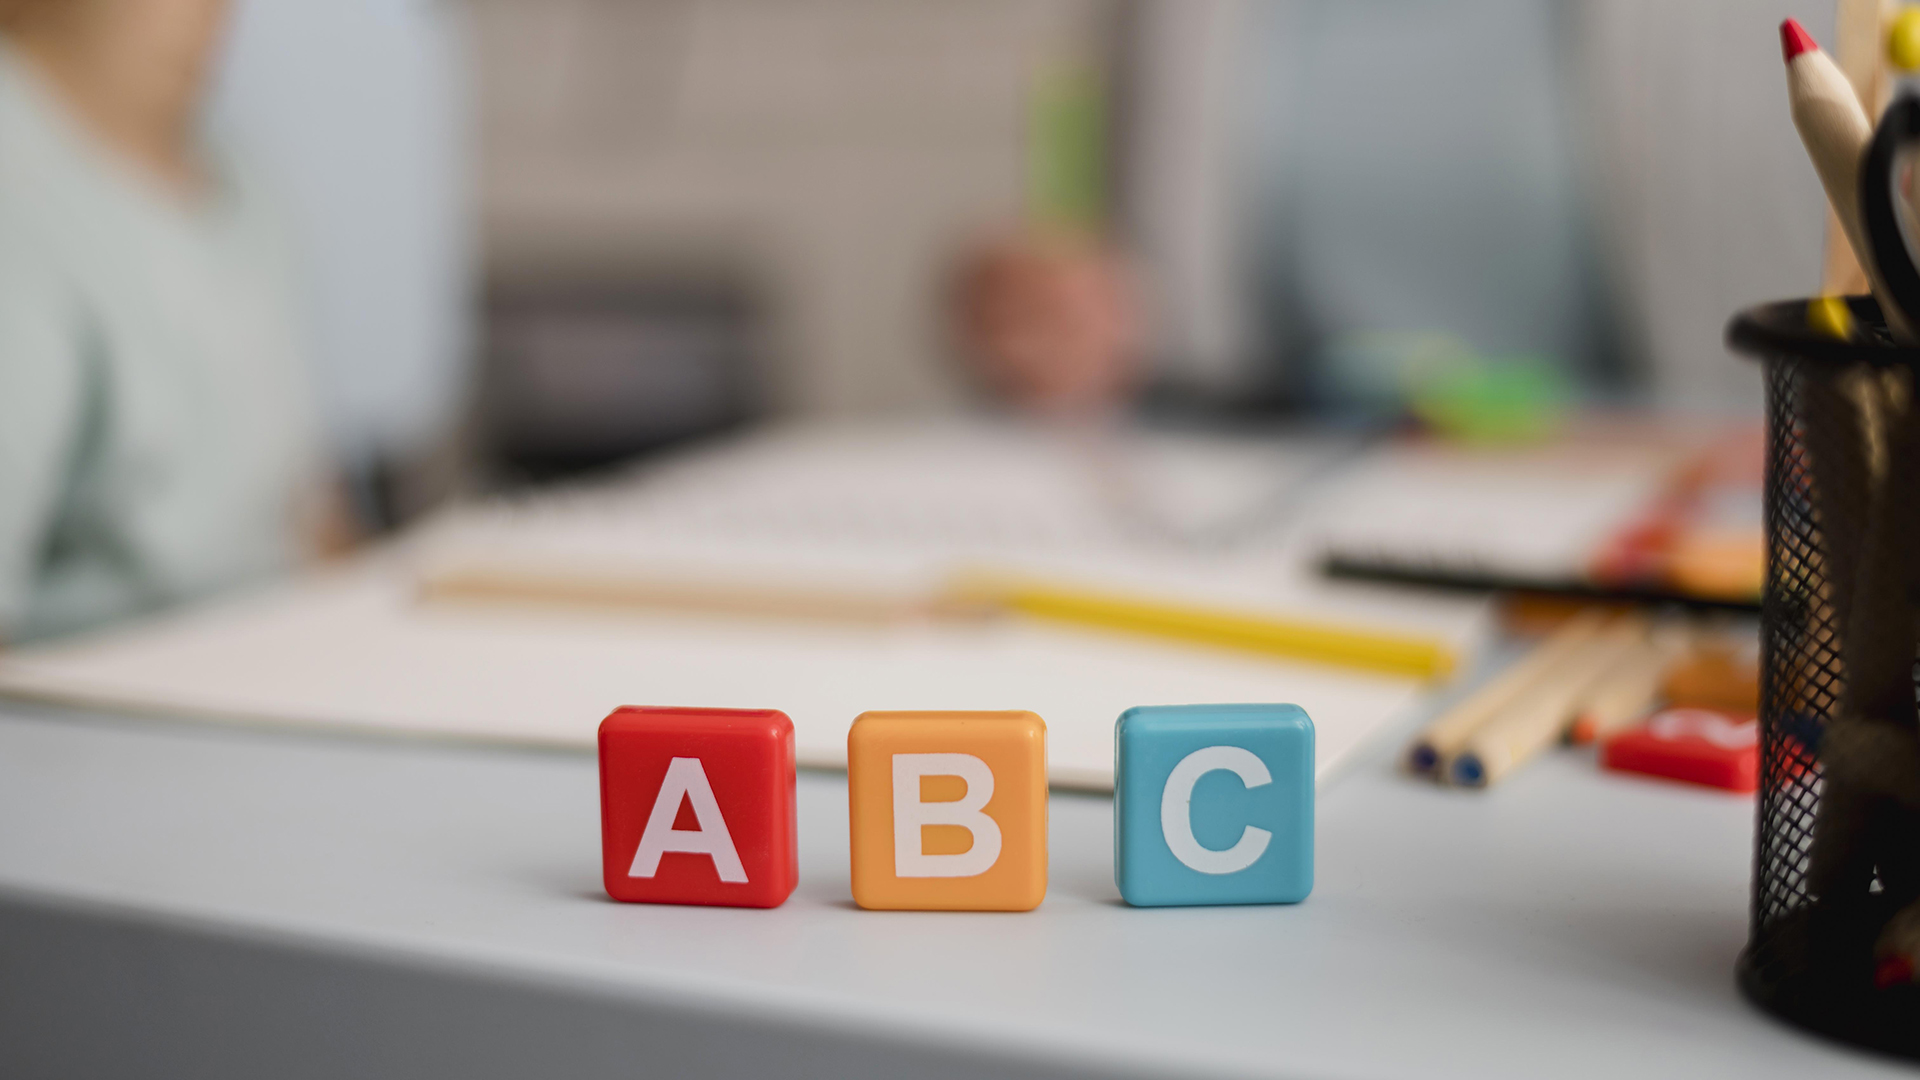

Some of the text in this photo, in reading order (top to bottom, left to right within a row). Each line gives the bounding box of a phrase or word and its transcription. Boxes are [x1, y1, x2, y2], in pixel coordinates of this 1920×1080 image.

[627, 757, 748, 883] A
[892, 753, 1002, 878] B
[1160, 746, 1272, 875] C
